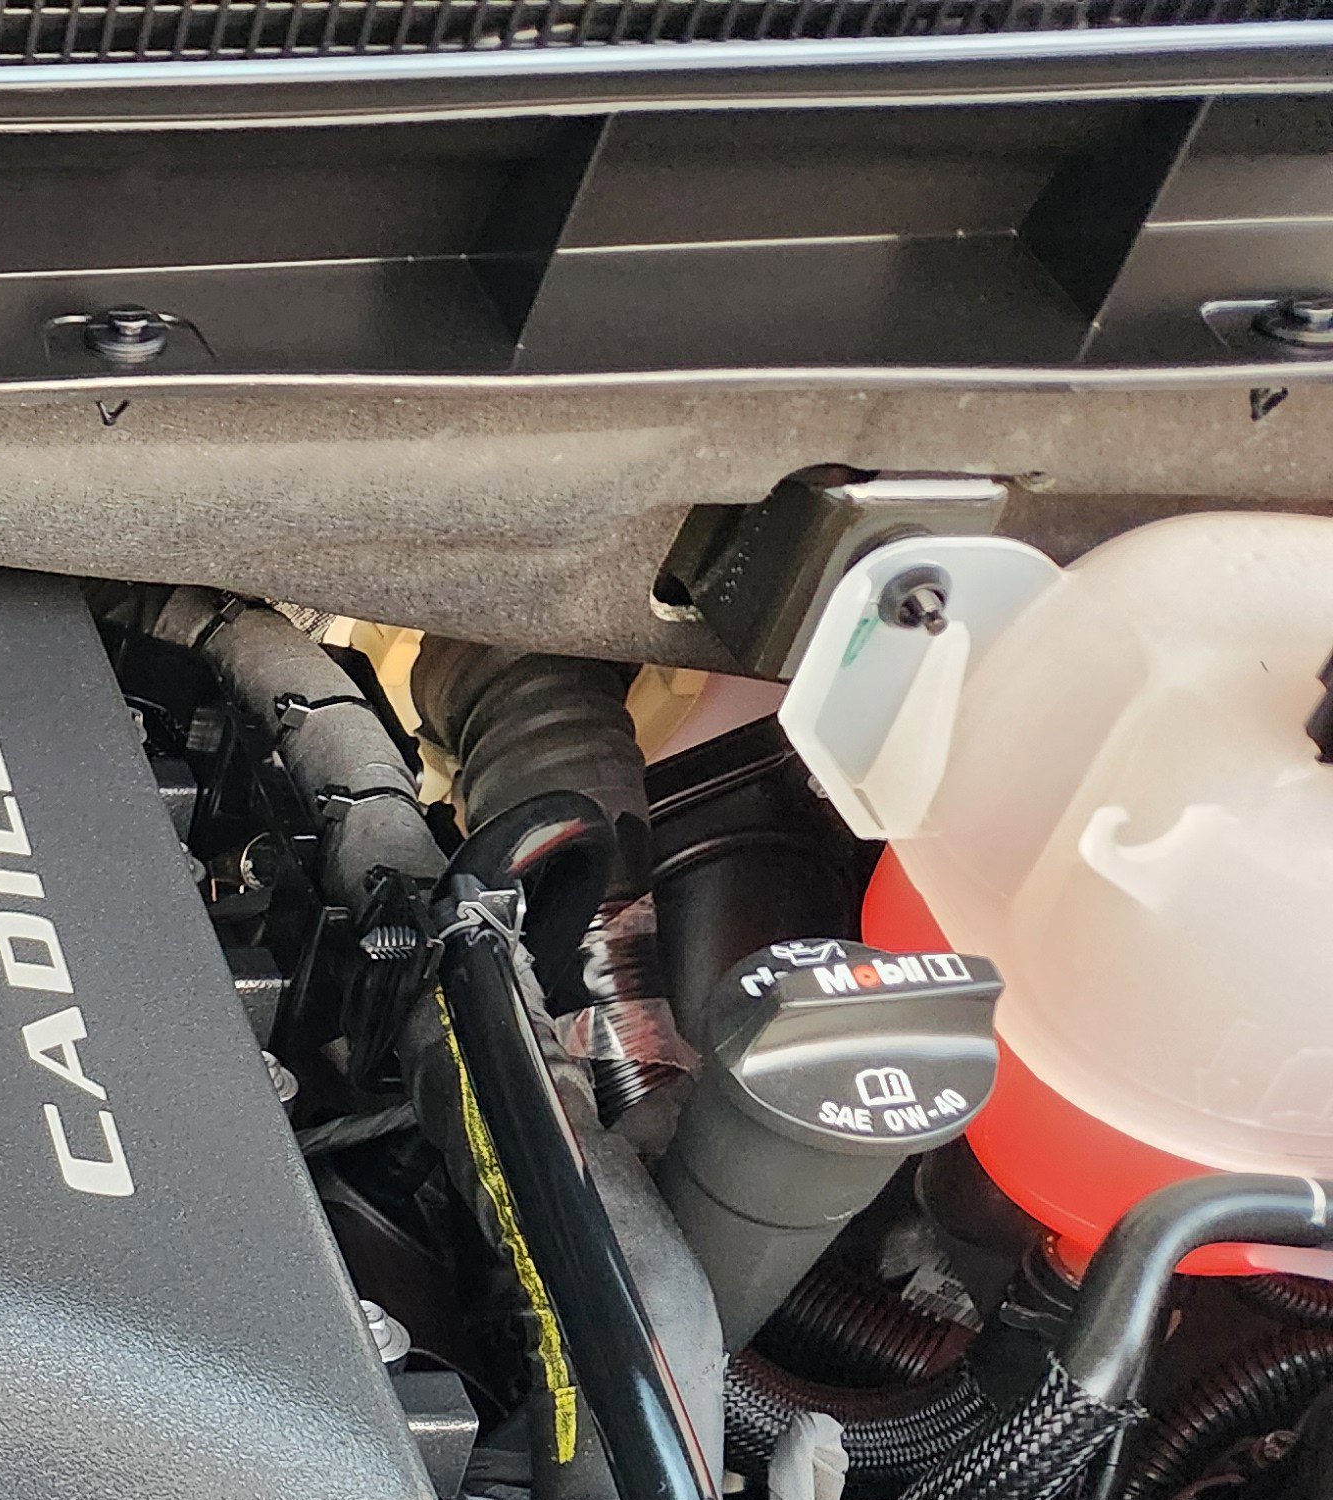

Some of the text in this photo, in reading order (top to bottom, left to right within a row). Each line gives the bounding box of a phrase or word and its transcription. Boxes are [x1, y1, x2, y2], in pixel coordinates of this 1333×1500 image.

[812, 956, 928, 995] Mobil
[819, 1088, 967, 1133] SAE 0W-40
